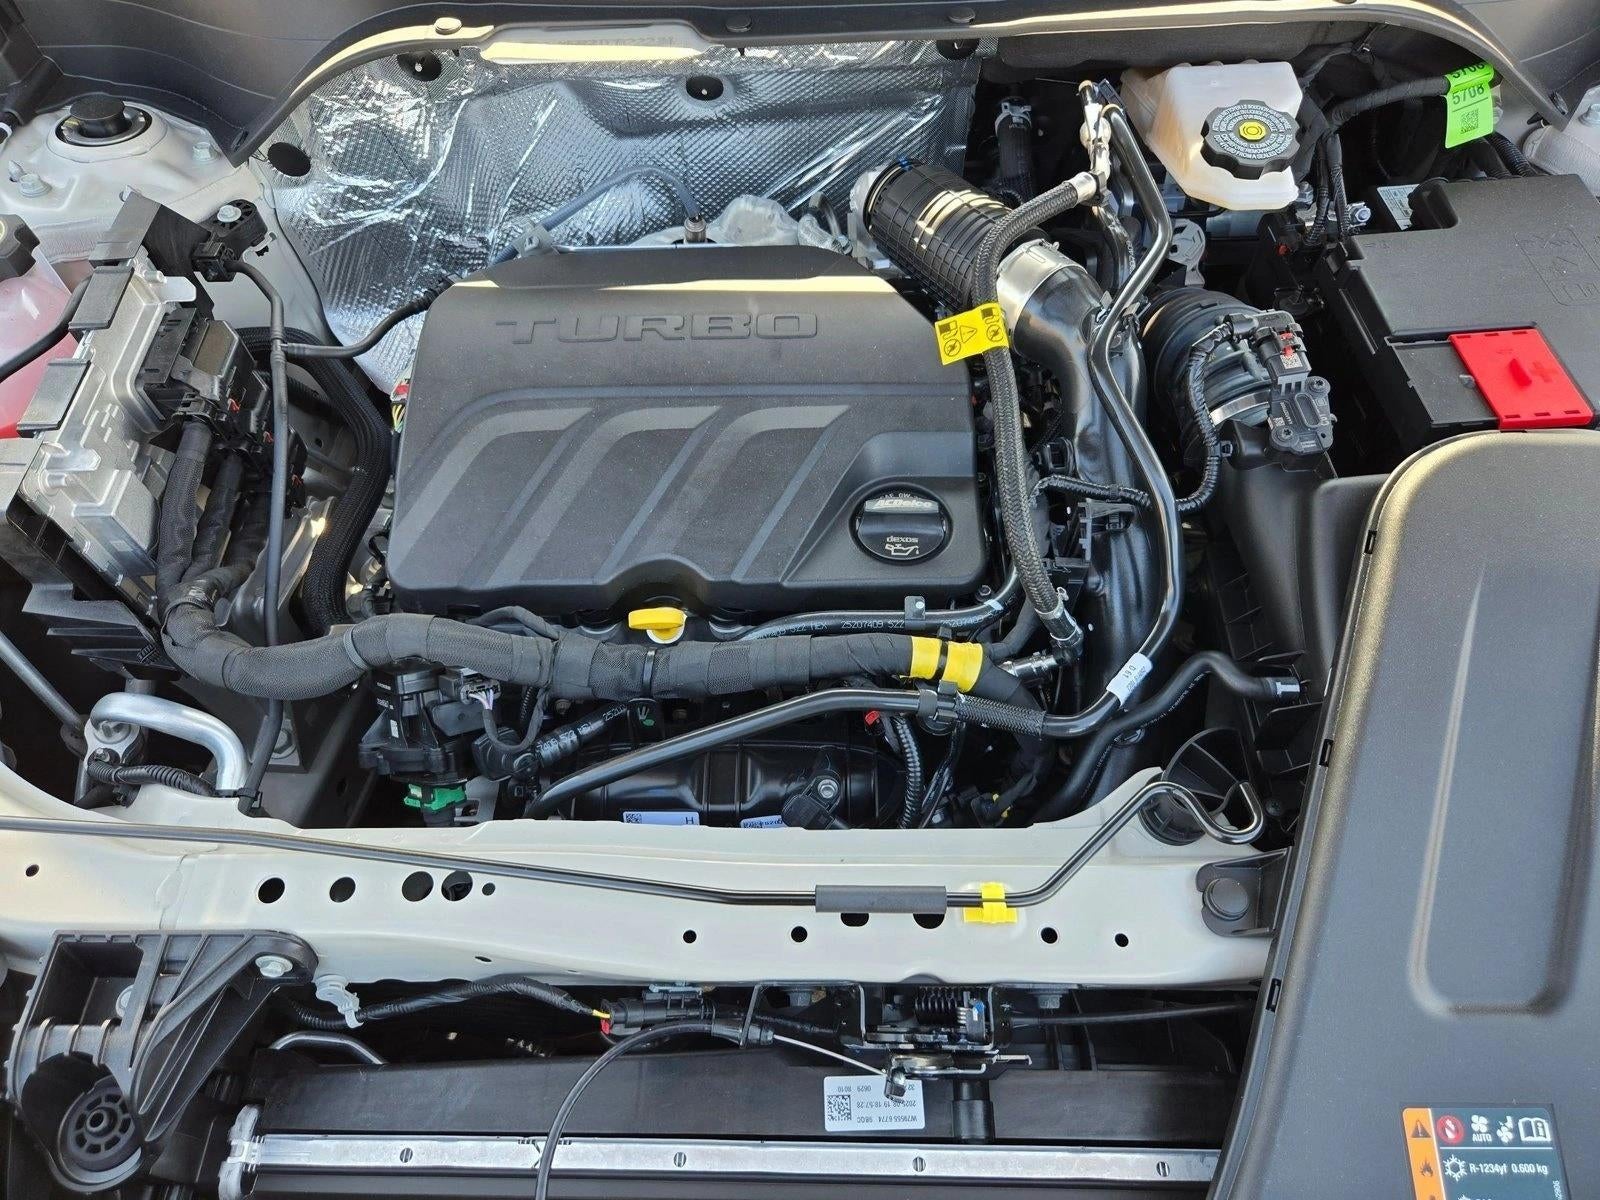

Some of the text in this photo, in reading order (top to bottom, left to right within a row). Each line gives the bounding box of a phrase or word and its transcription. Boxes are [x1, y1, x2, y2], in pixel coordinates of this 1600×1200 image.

[496, 311, 819, 346] TURBO
[886, 535, 919, 543] dexos
[685, 816, 694, 825] H
[1472, 1132, 1492, 1142] AUTO
[1511, 1162, 1536, 1174] 0.600
[1537, 1162, 1549, 1175] kg
